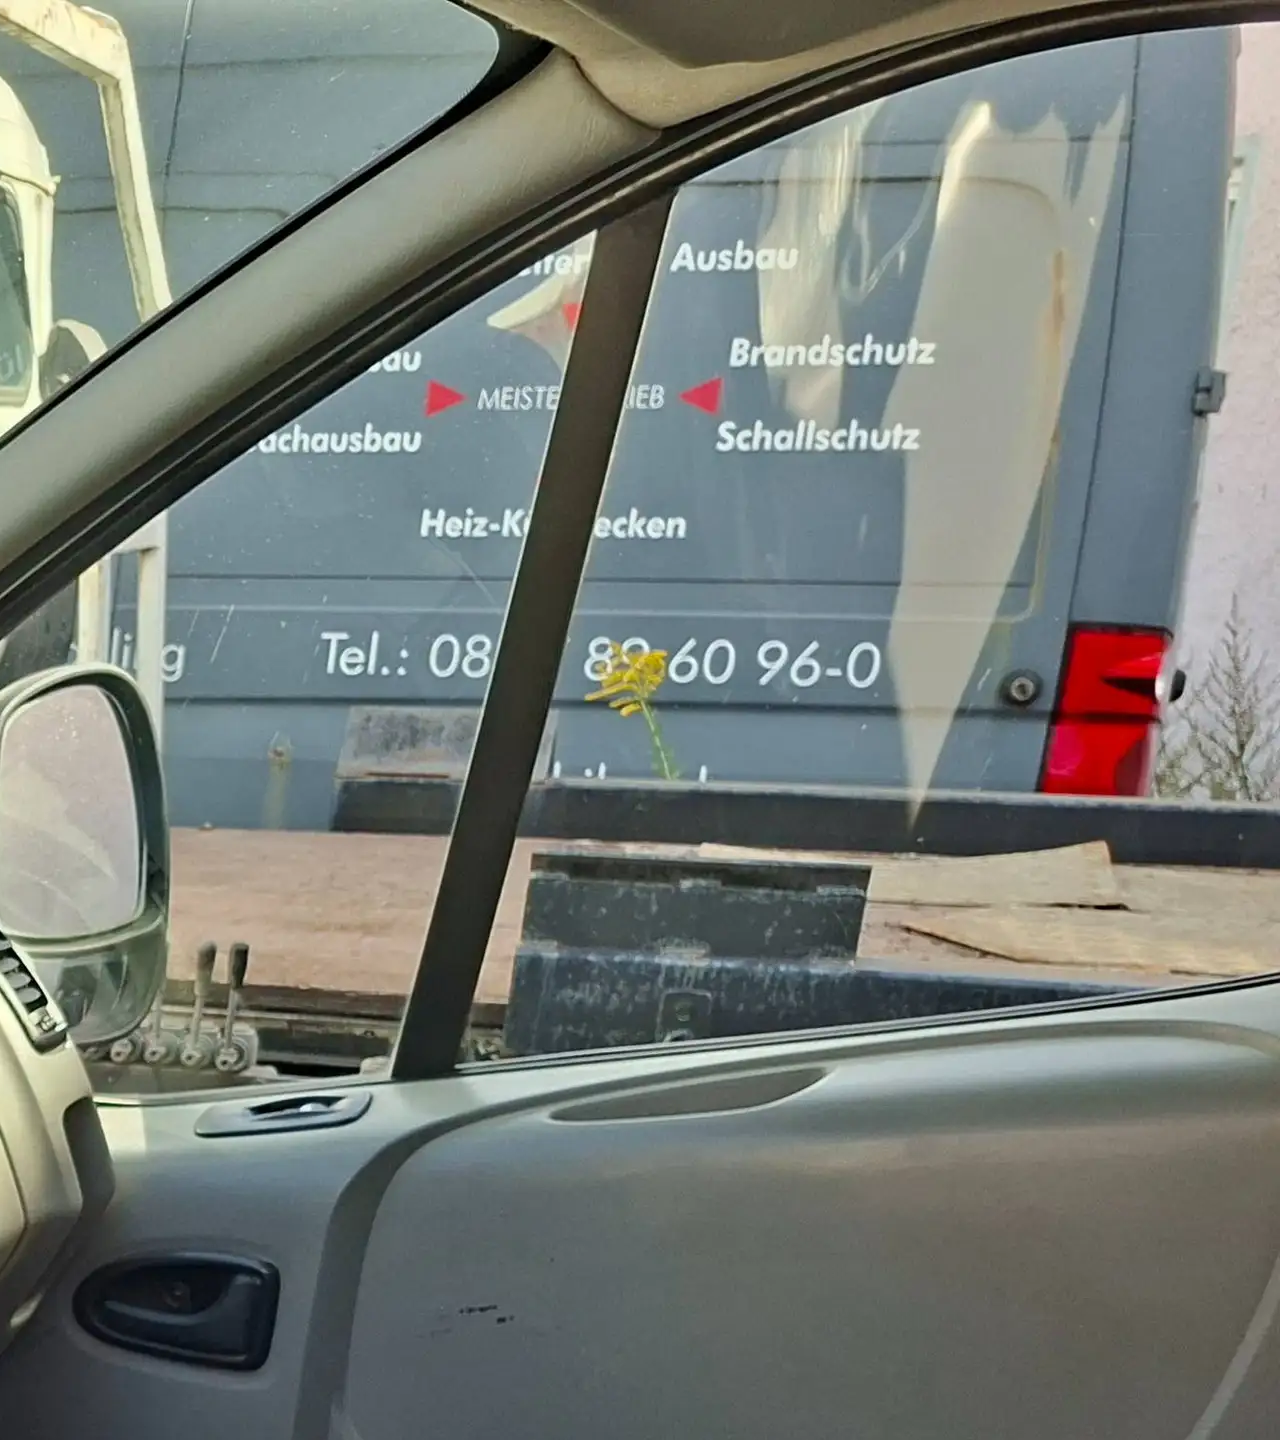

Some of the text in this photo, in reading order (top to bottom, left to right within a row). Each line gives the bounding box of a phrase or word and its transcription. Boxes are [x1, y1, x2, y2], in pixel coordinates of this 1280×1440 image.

[670, 239, 799, 273] Ausbau
[729, 333, 938, 368] Brandschutz
[715, 419, 921, 452] Schallschutz
[320, 630, 409, 676] Tel.:
[668, 637, 736, 685] 60
[756, 640, 882, 689] 96-0
